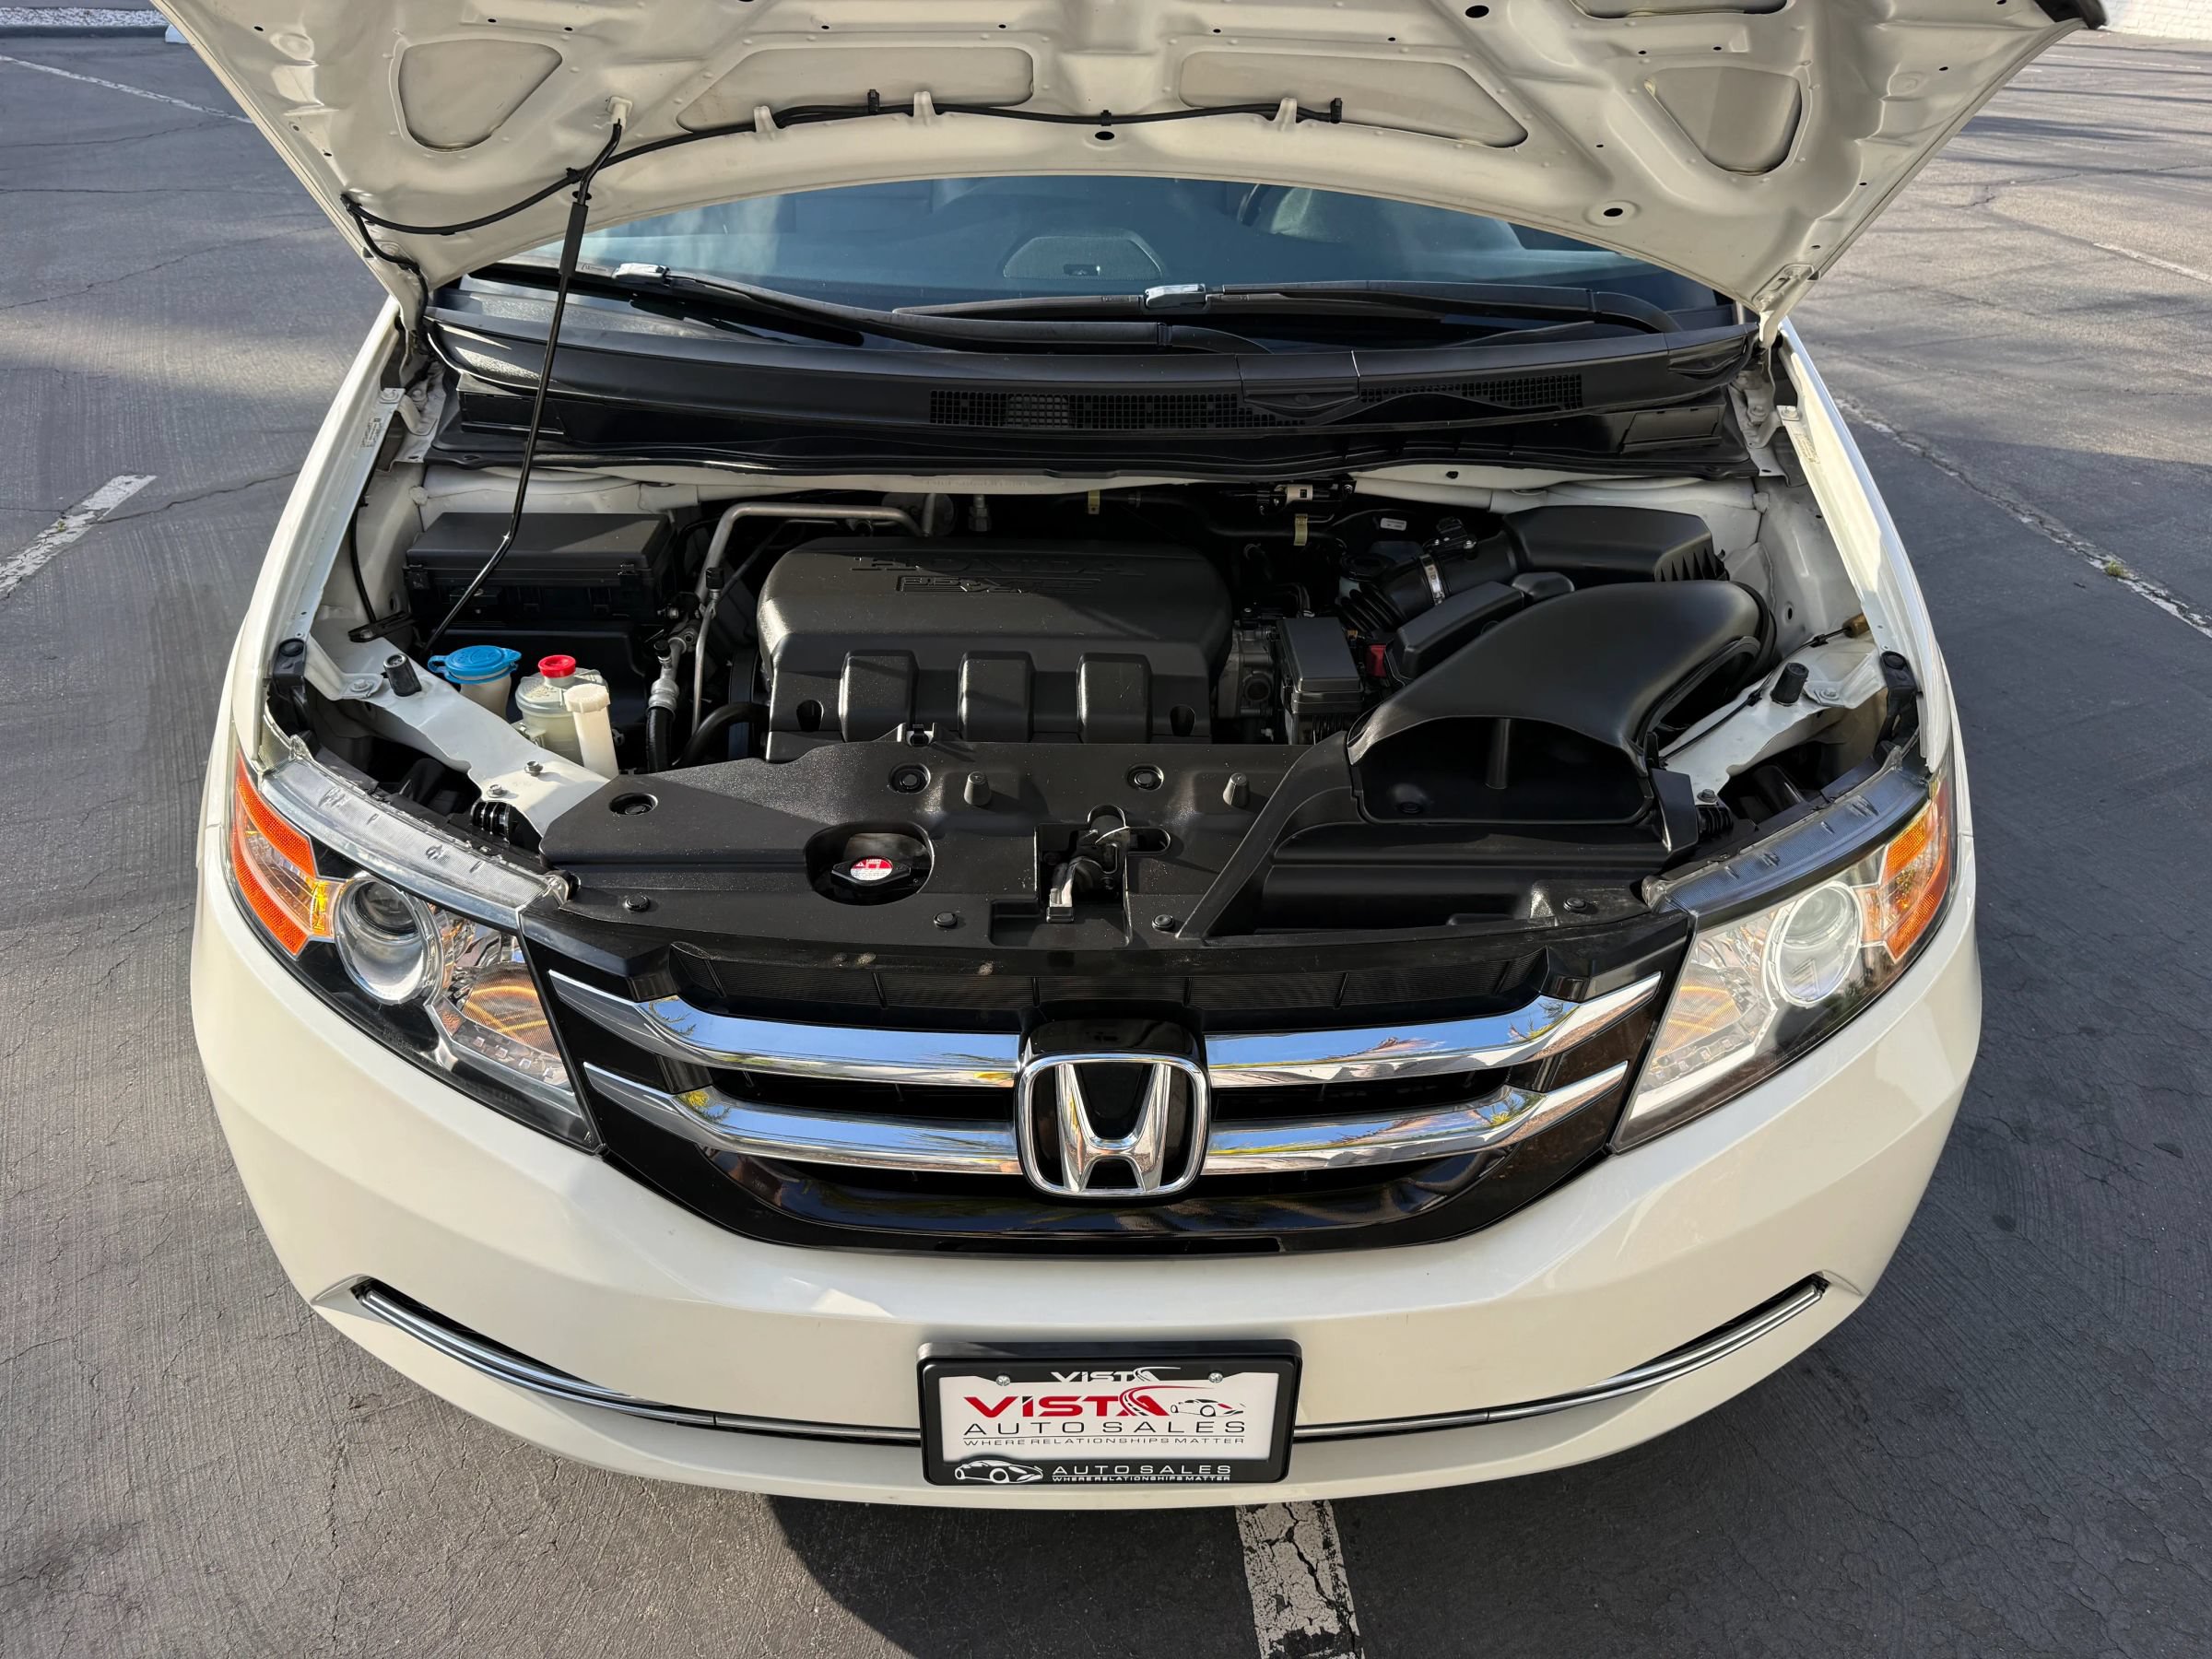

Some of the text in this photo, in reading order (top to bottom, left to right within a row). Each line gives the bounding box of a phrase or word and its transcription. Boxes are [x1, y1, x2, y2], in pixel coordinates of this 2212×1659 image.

[1051, 1368, 1165, 1383] VISTA
[964, 1388, 1174, 1418] VISTA
[963, 1420, 1245, 1436] AUTO SALES
[1052, 1465, 1231, 1476] AUTO SALES
